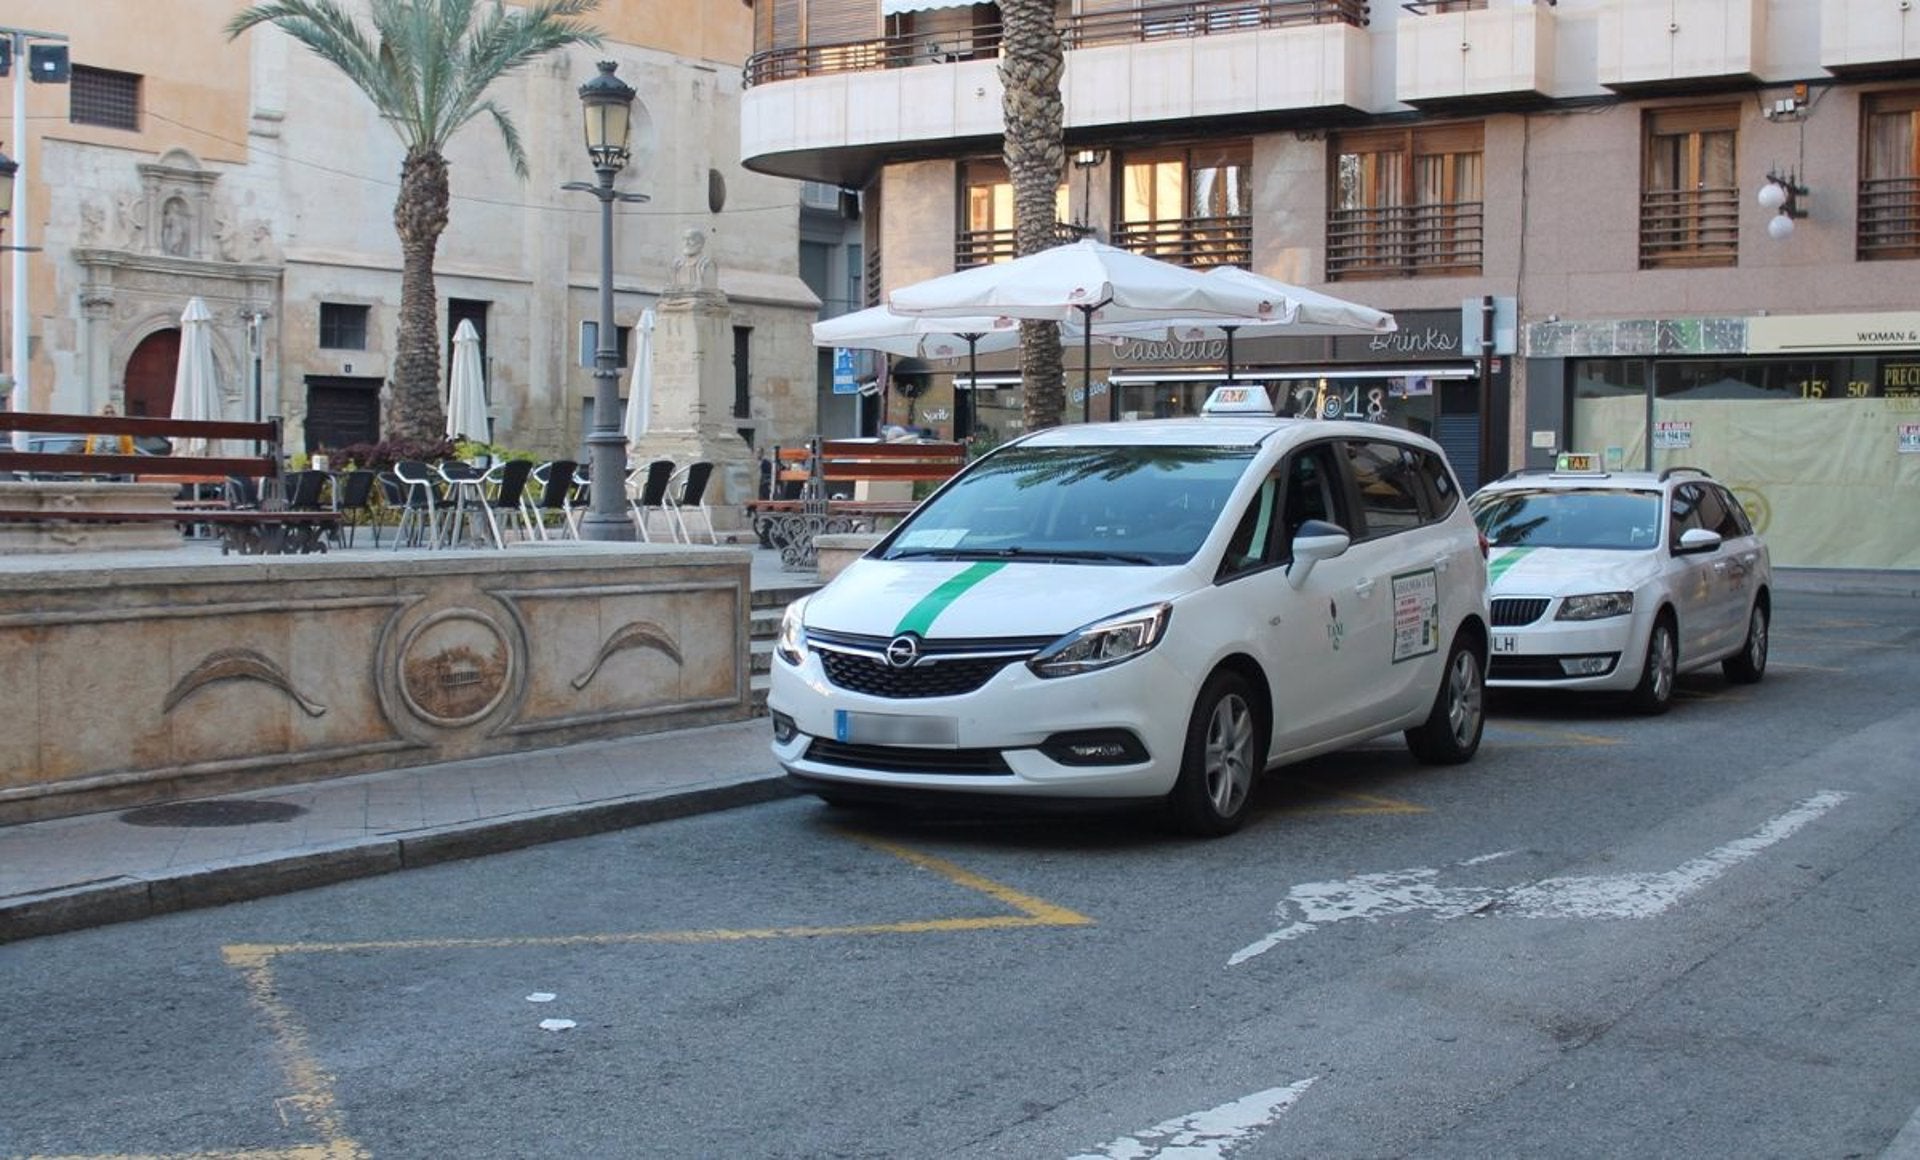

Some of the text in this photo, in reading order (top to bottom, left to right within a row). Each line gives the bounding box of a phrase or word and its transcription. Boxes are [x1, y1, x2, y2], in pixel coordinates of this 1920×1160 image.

[1857, 331, 1905, 341] WOMAN
[1215, 389, 1248, 403] TAXI
[1568, 456, 1589, 470] TAXI
[1491, 636, 1515, 652] LH
